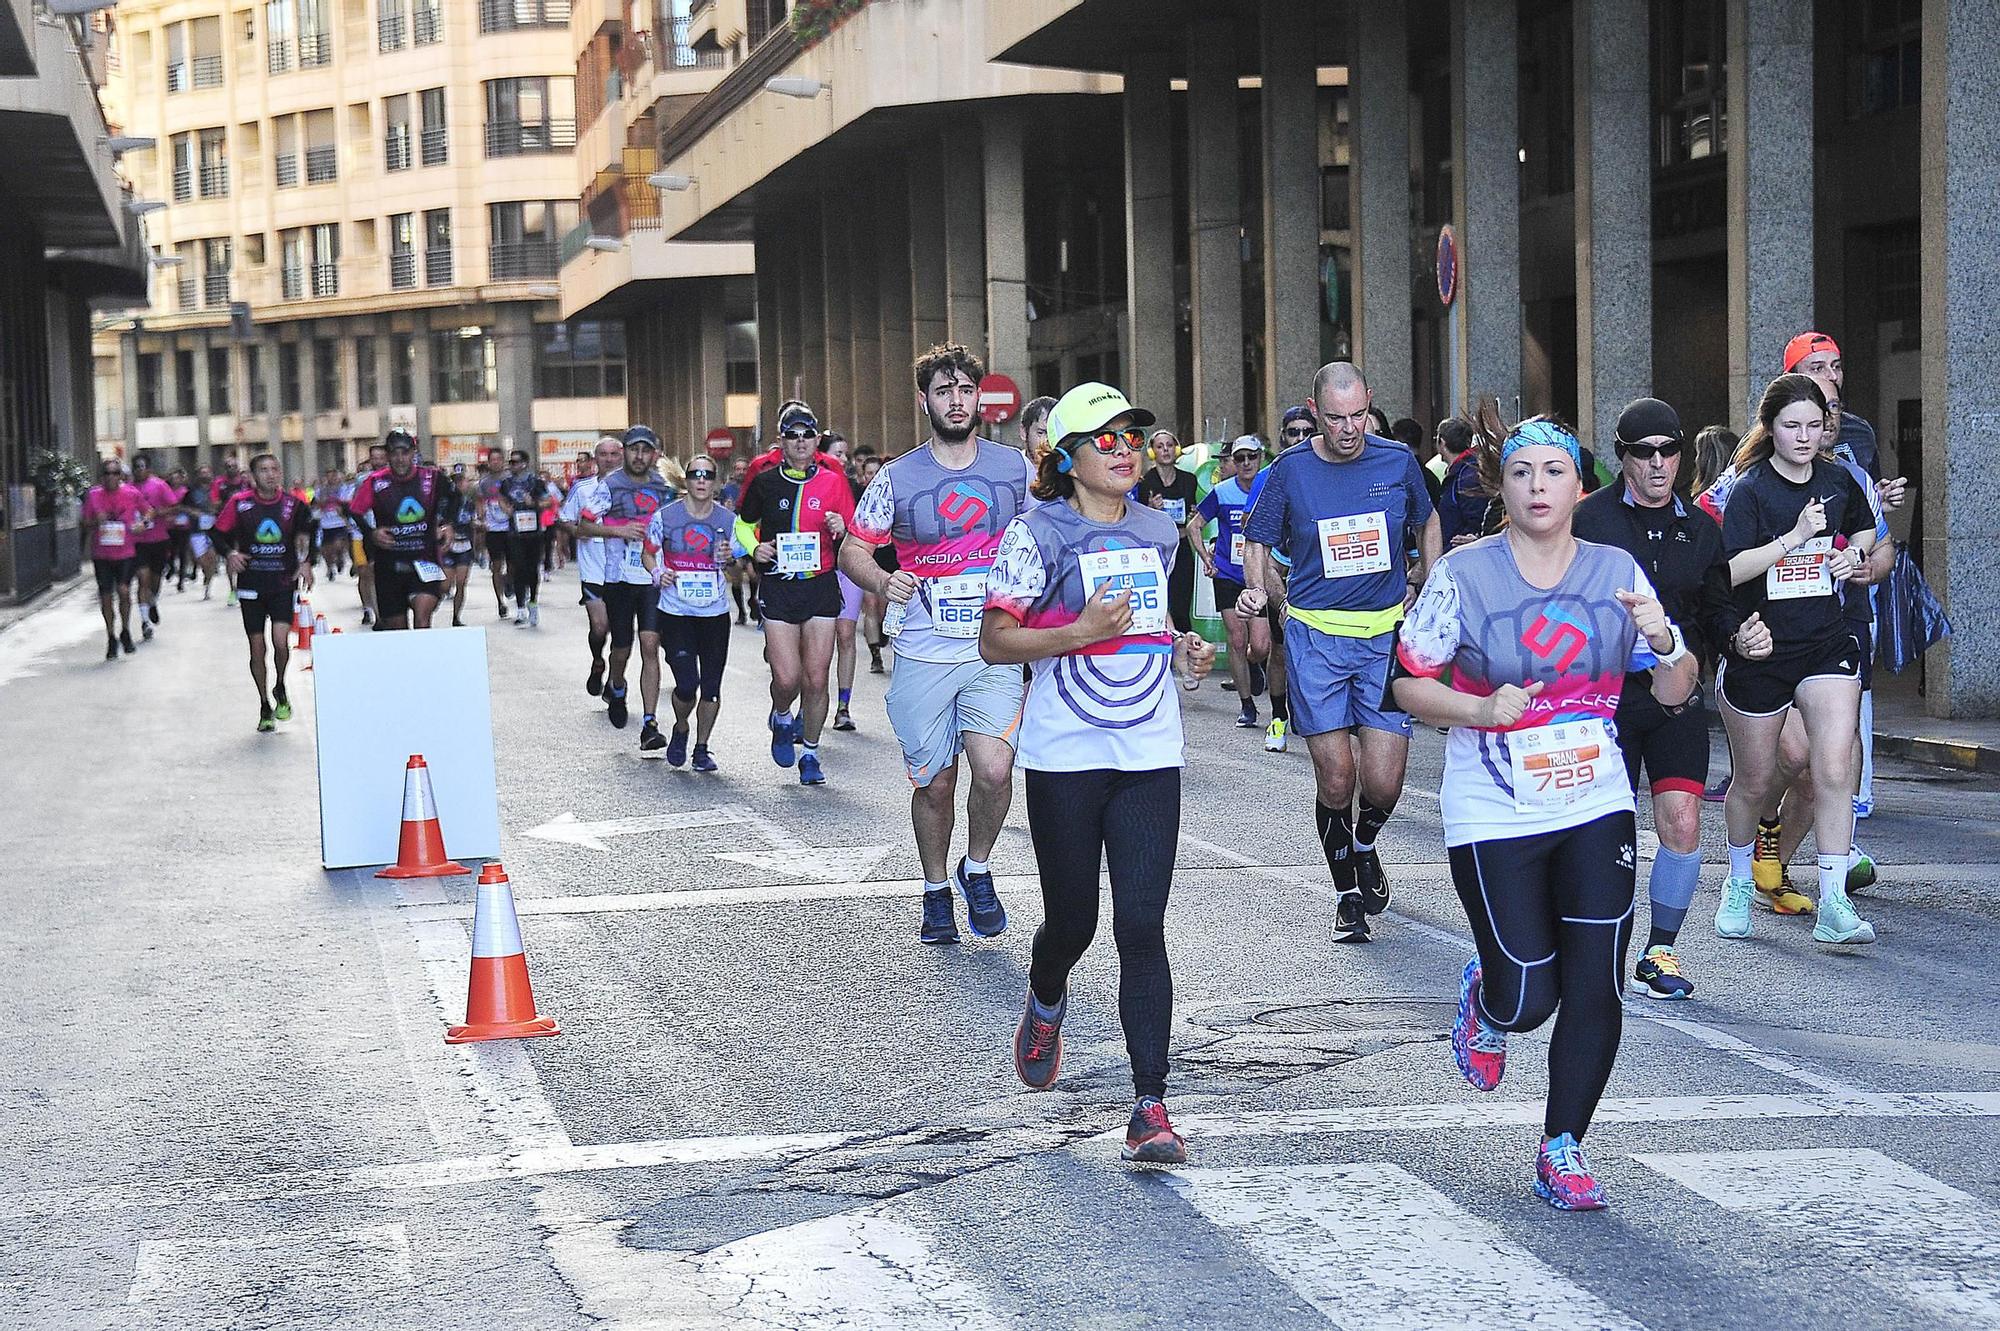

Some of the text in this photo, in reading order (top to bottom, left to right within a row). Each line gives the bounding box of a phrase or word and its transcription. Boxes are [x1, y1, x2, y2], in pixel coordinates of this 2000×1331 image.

[914, 553, 963, 565] MEDIA
[1330, 543, 1379, 561] 1236
[1776, 566, 1820, 582] 1235
[1546, 749, 1579, 768] TRIANA
[1532, 764, 1595, 792] 729
